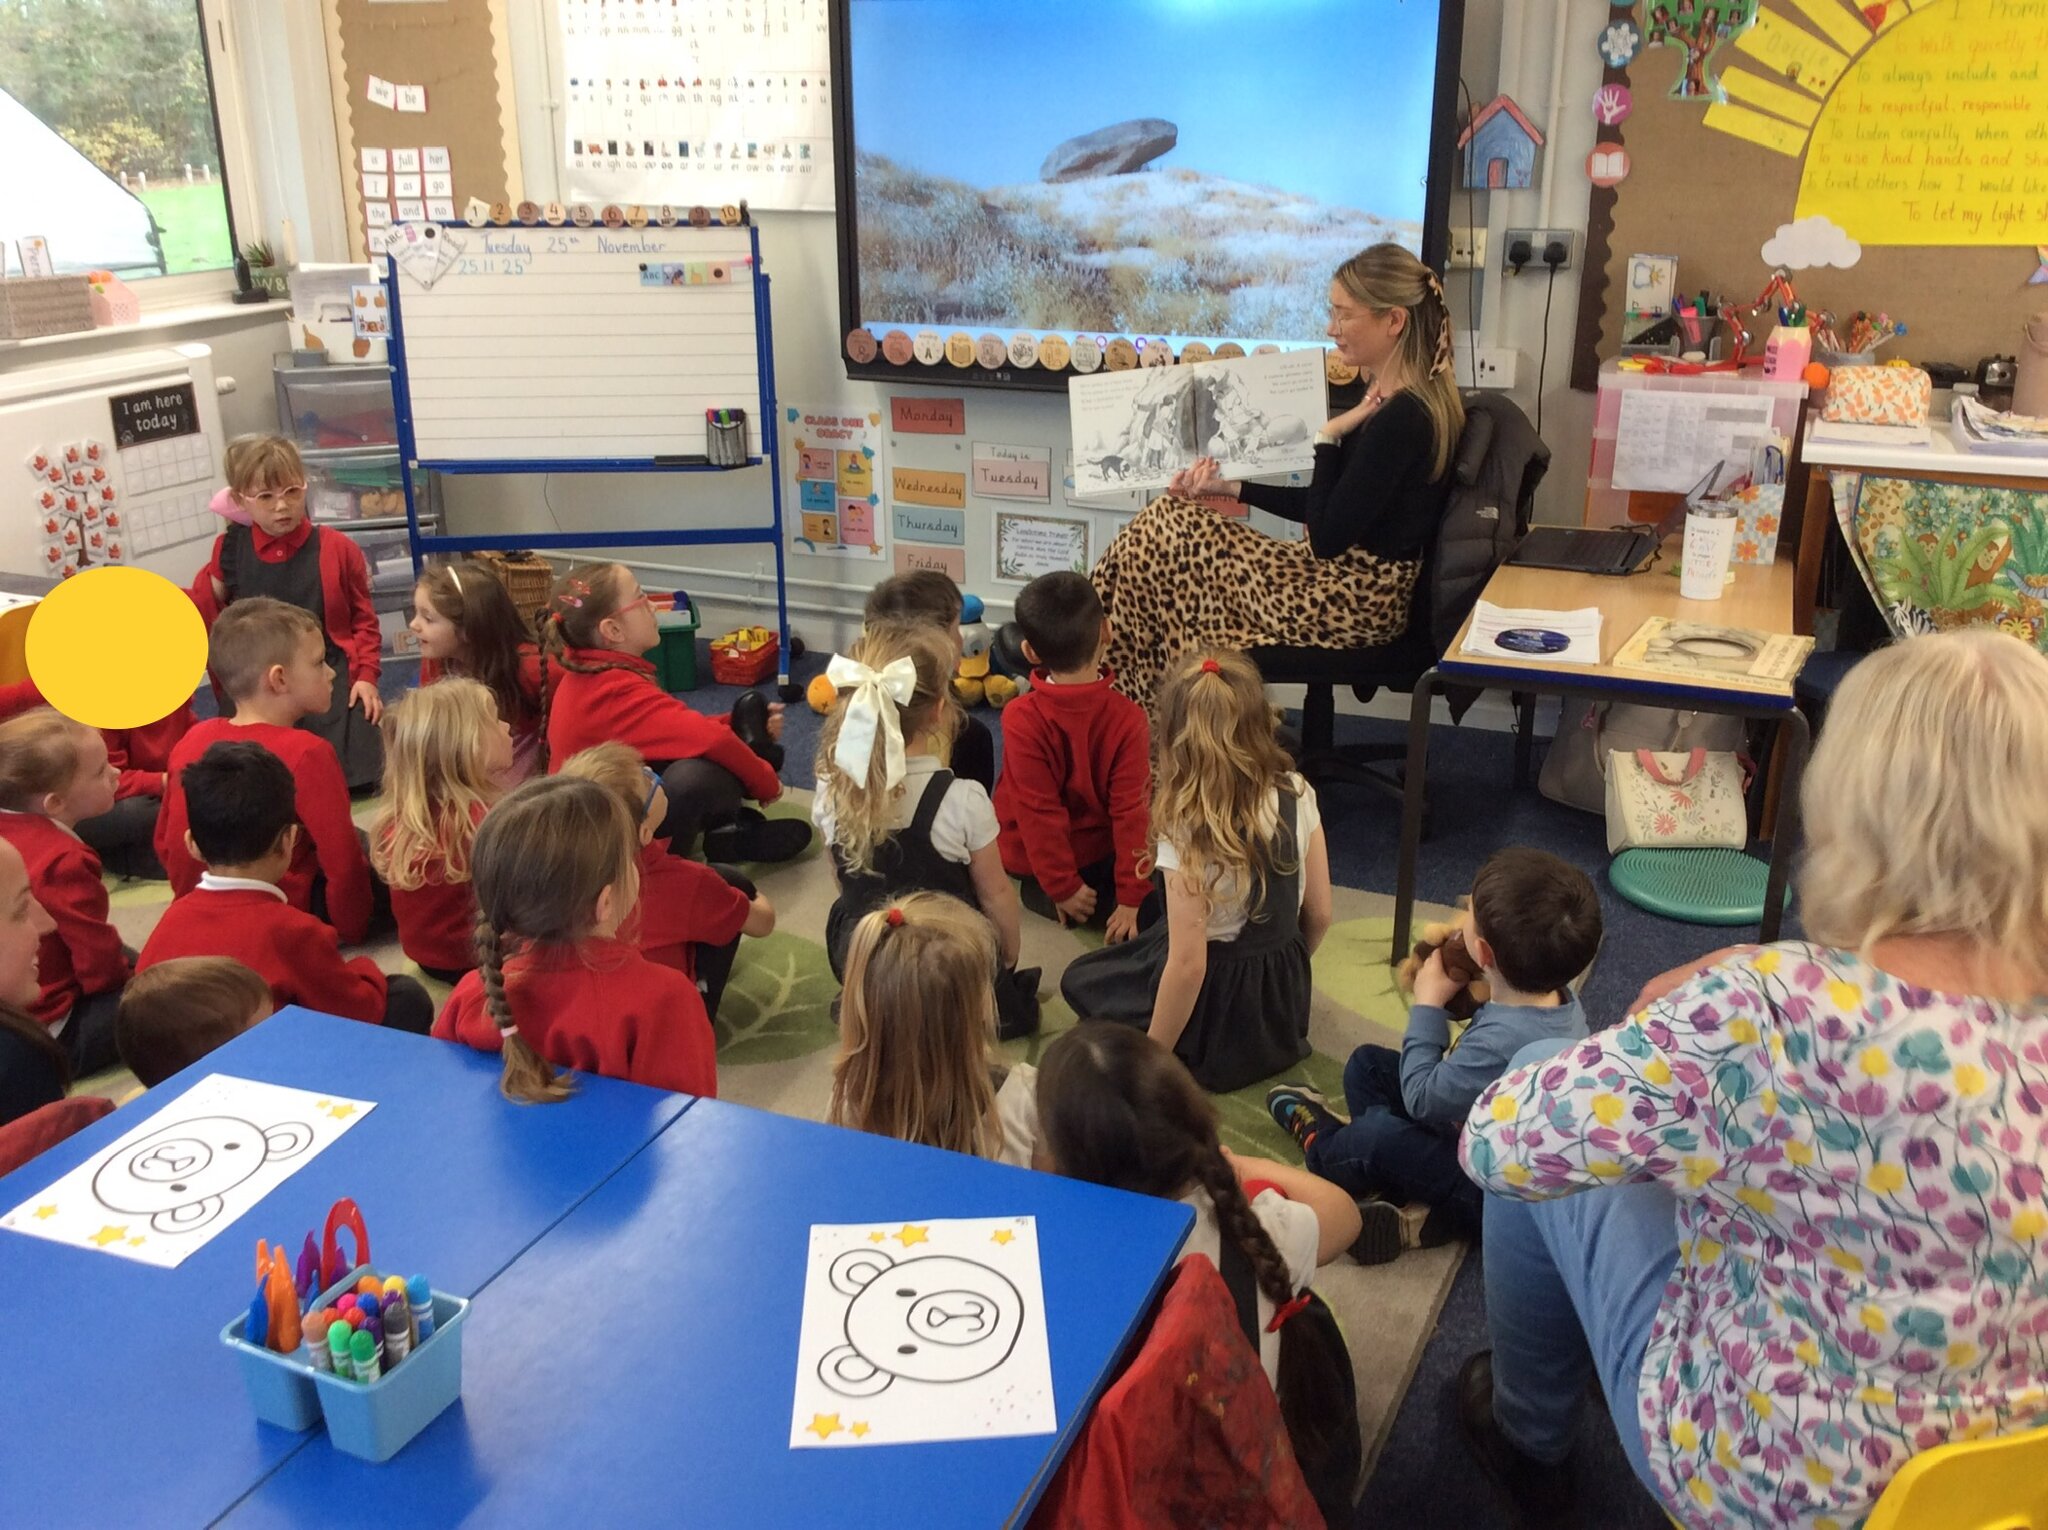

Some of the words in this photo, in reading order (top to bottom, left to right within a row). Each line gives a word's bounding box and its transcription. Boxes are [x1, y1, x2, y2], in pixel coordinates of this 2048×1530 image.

[1883, 63, 1932, 92] always
[1946, 63, 1997, 81] include
[2010, 61, 2038, 81] and
[1858, 93, 1872, 113] be
[1962, 94, 2031, 117] responsible
[1856, 121, 1890, 138] listen
[1901, 121, 1960, 151] carefully
[1980, 147, 2013, 167] and
[1866, 172, 1908, 190] others
[1918, 169, 1941, 191] how
[1956, 174, 1965, 192] I
[372, 209, 386, 218] the
[403, 205, 420, 216] and
[435, 206, 447, 216] no
[722, 205, 736, 218] 10
[1903, 200, 1921, 219] To
[1933, 202, 1954, 220] let
[1962, 208, 1983, 235] my
[1991, 199, 2026, 236] light
[383, 230, 403, 248] ABC
[481, 231, 533, 264] Tuesday
[598, 234, 667, 253] November
[123, 402, 130, 415] I
[133, 399, 153, 414] am
[155, 394, 183, 409] here
[136, 413, 177, 432] today
[900, 407, 954, 428] Monday
[990, 446, 1018, 461] Today
[1021, 450, 1030, 460] is
[894, 477, 963, 501] Wednesday
[981, 467, 1038, 490] Tuesday
[897, 513, 958, 538] Thursday
[907, 553, 948, 575] Friday
